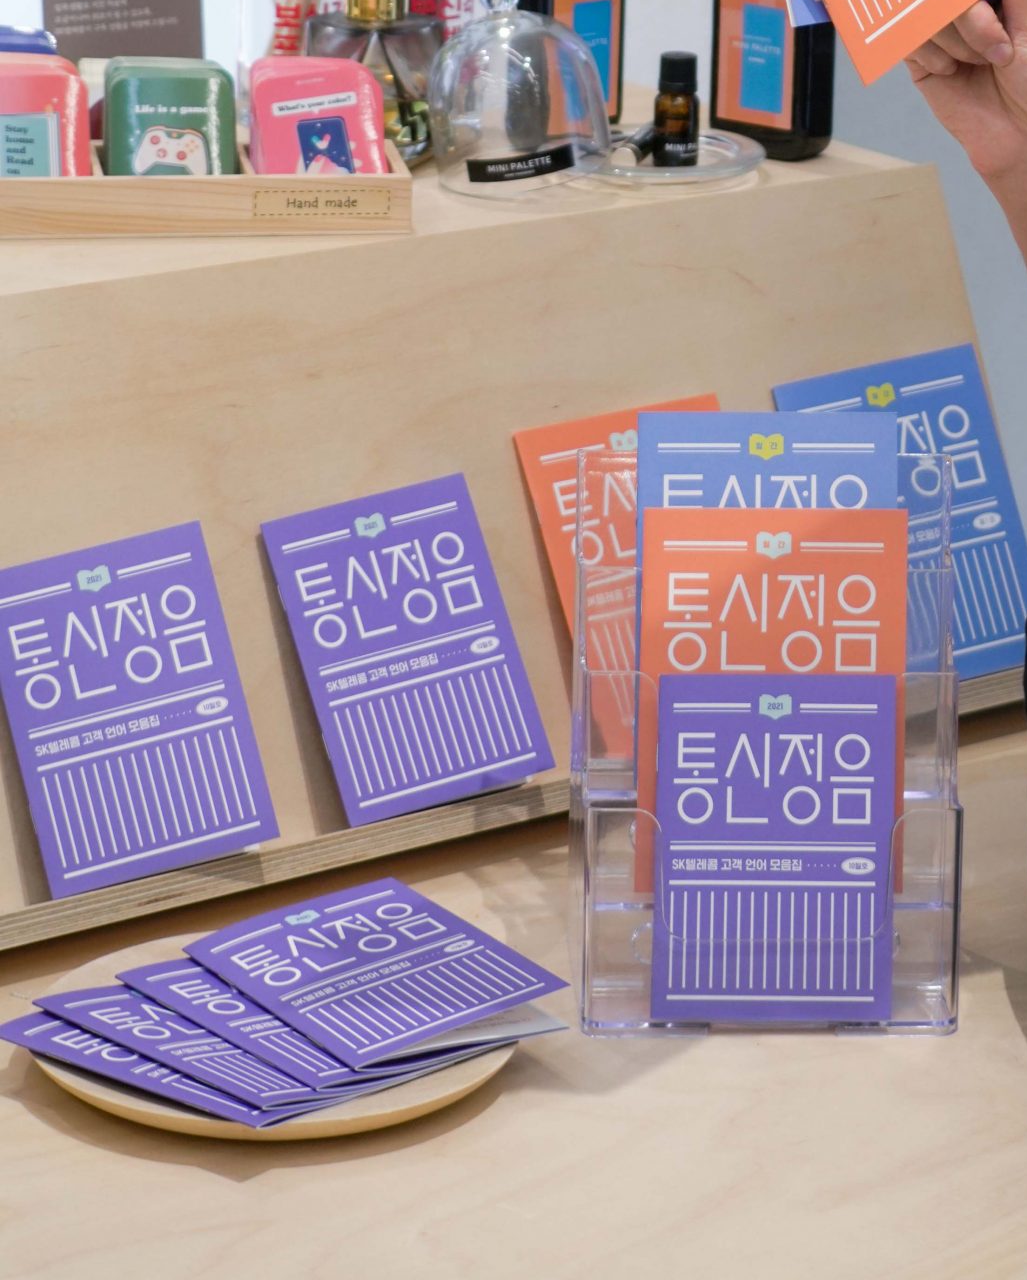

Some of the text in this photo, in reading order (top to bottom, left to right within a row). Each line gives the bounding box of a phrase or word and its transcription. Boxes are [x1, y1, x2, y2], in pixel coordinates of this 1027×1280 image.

[135, 105, 155, 113] Life
[158, 104, 167, 112] is
[5, 124, 28, 135] Stay
[6, 136, 34, 144] home
[7, 146, 26, 154] and
[6, 156, 34, 166] Read
[487, 161, 510, 174] MINI
[511, 155, 551, 171] PALETTE
[286, 196, 358, 208] Hand made
[295, 531, 484, 649] 통신정음
[664, 573, 881, 672] 통신정음
[8, 585, 213, 709] 통신정음
[326, 652, 439, 693] SK텔레콤 고객 언어 모음집
[767, 702, 784, 711] 2021
[34, 714, 161, 757] SK텔레콤 고객 언어 모음집
[673, 732, 875, 825] 통신정음
[672, 858, 802, 872] SK텔레콤 고객 언어 모음집
